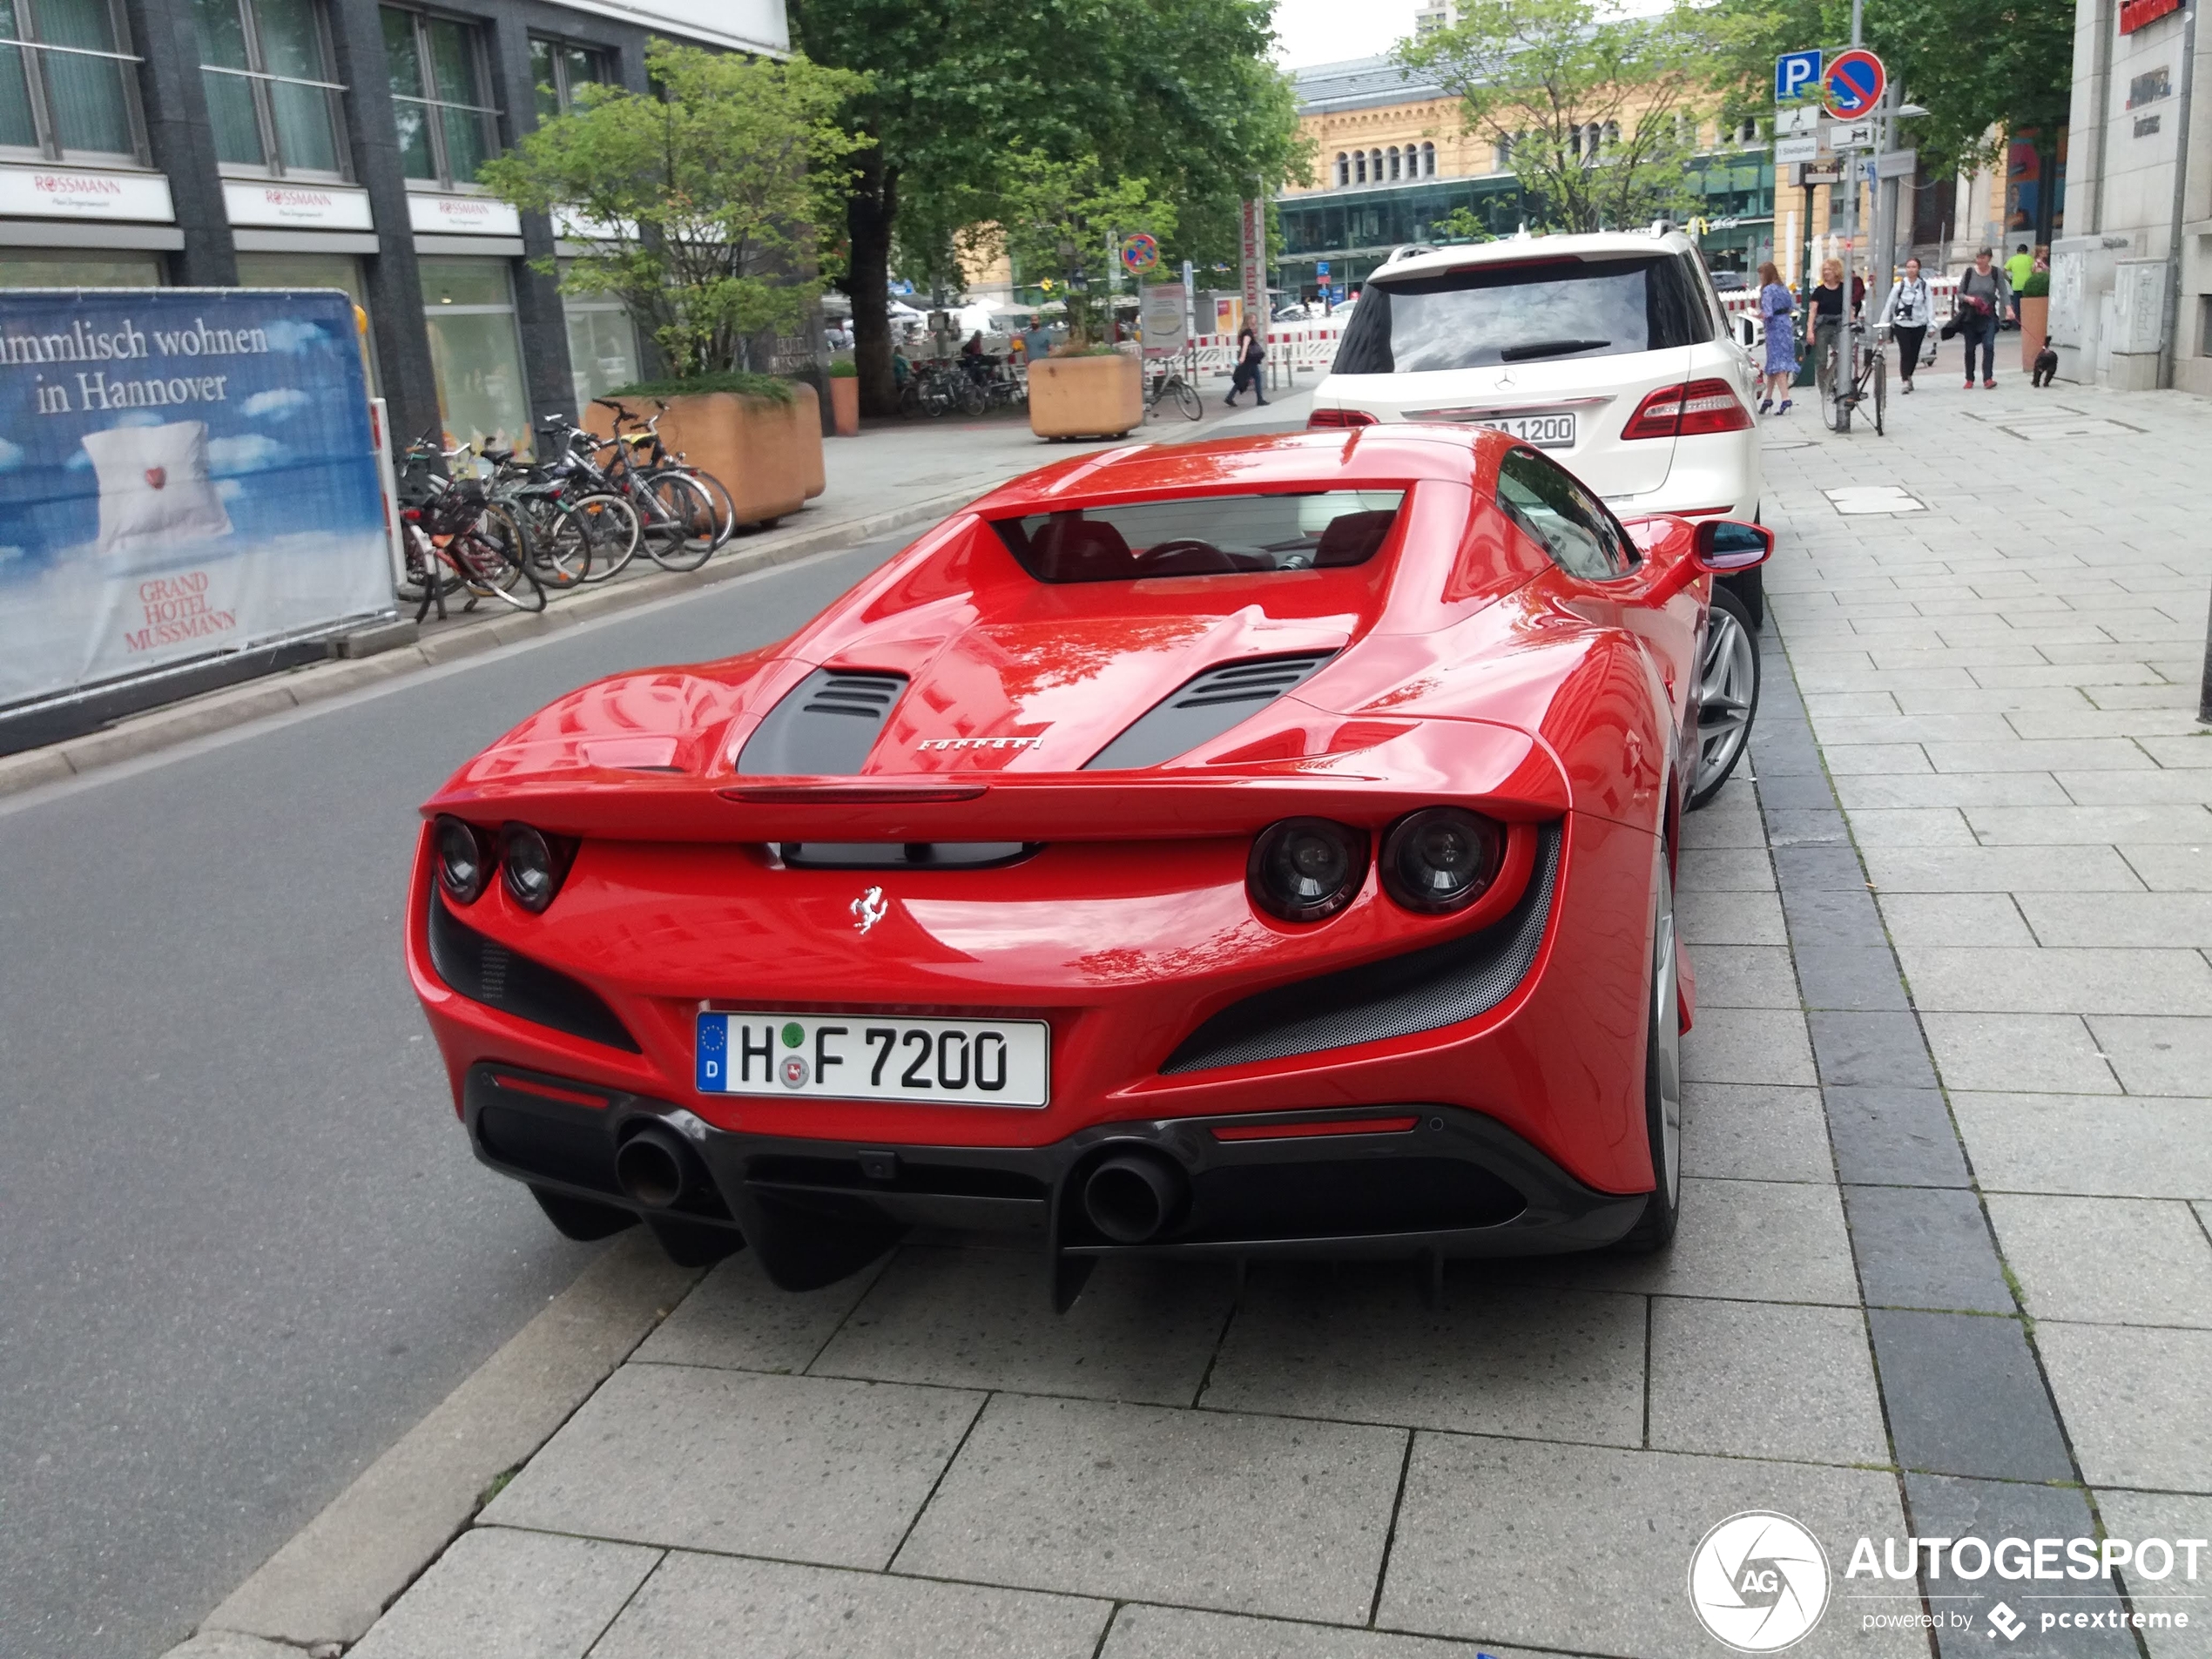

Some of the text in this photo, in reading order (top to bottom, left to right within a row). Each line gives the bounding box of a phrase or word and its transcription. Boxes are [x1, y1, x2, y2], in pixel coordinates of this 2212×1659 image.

[1786, 58, 1811, 95] P
[34, 175, 121, 193] ROSSMANN
[265, 188, 333, 206] ROSSMANN
[439, 201, 489, 215] ROSSMANN
[1243, 200, 1256, 307] HOTEL MUSSMA
[153, 317, 268, 358] wohnen
[36, 371, 227, 415] in Hannover
[1517, 418, 1572, 441] 1200
[139, 571, 208, 603] GRAND
[143, 593, 212, 625] HOTEL
[125, 609, 236, 652] MUSSMANN
[917, 738, 1043, 751] Ferrari
[706, 1060, 718, 1078] D
[742, 1025, 1007, 1090] H F 7200
